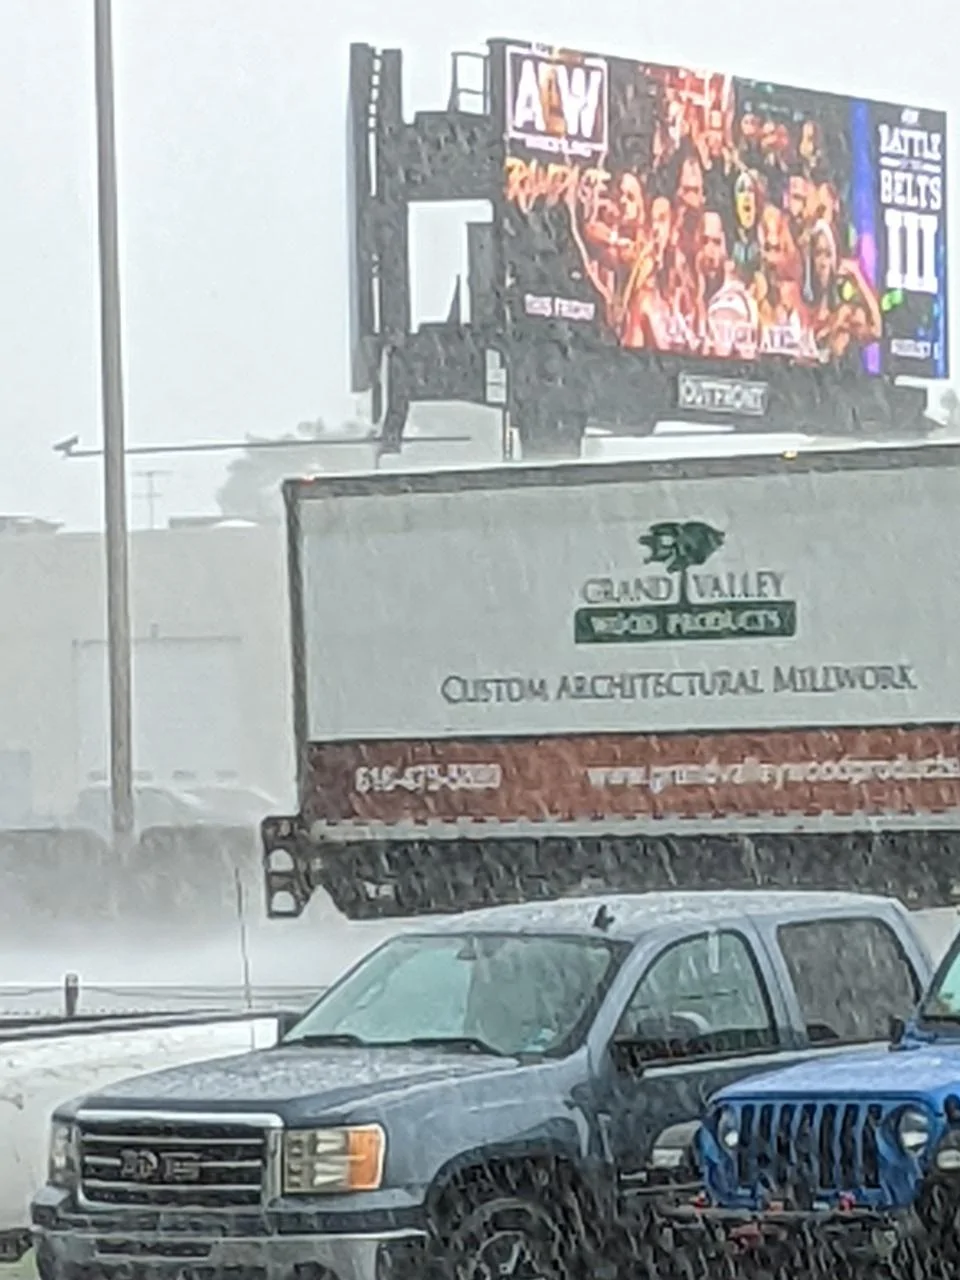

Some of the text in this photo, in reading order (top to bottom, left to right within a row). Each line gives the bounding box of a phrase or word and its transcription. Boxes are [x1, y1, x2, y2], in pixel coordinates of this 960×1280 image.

[515, 60, 601, 138] AEW
[879, 124, 941, 160] BATTLE
[880, 169, 942, 210] BELTS
[885, 208, 938, 294] III
[583, 571, 784, 604] GRAND VALLEY
[591, 609, 781, 634] WOOD PRODUCTS
[556, 669, 763, 700] ARCHITECTURAL
[774, 664, 917, 693] MILLWORK
